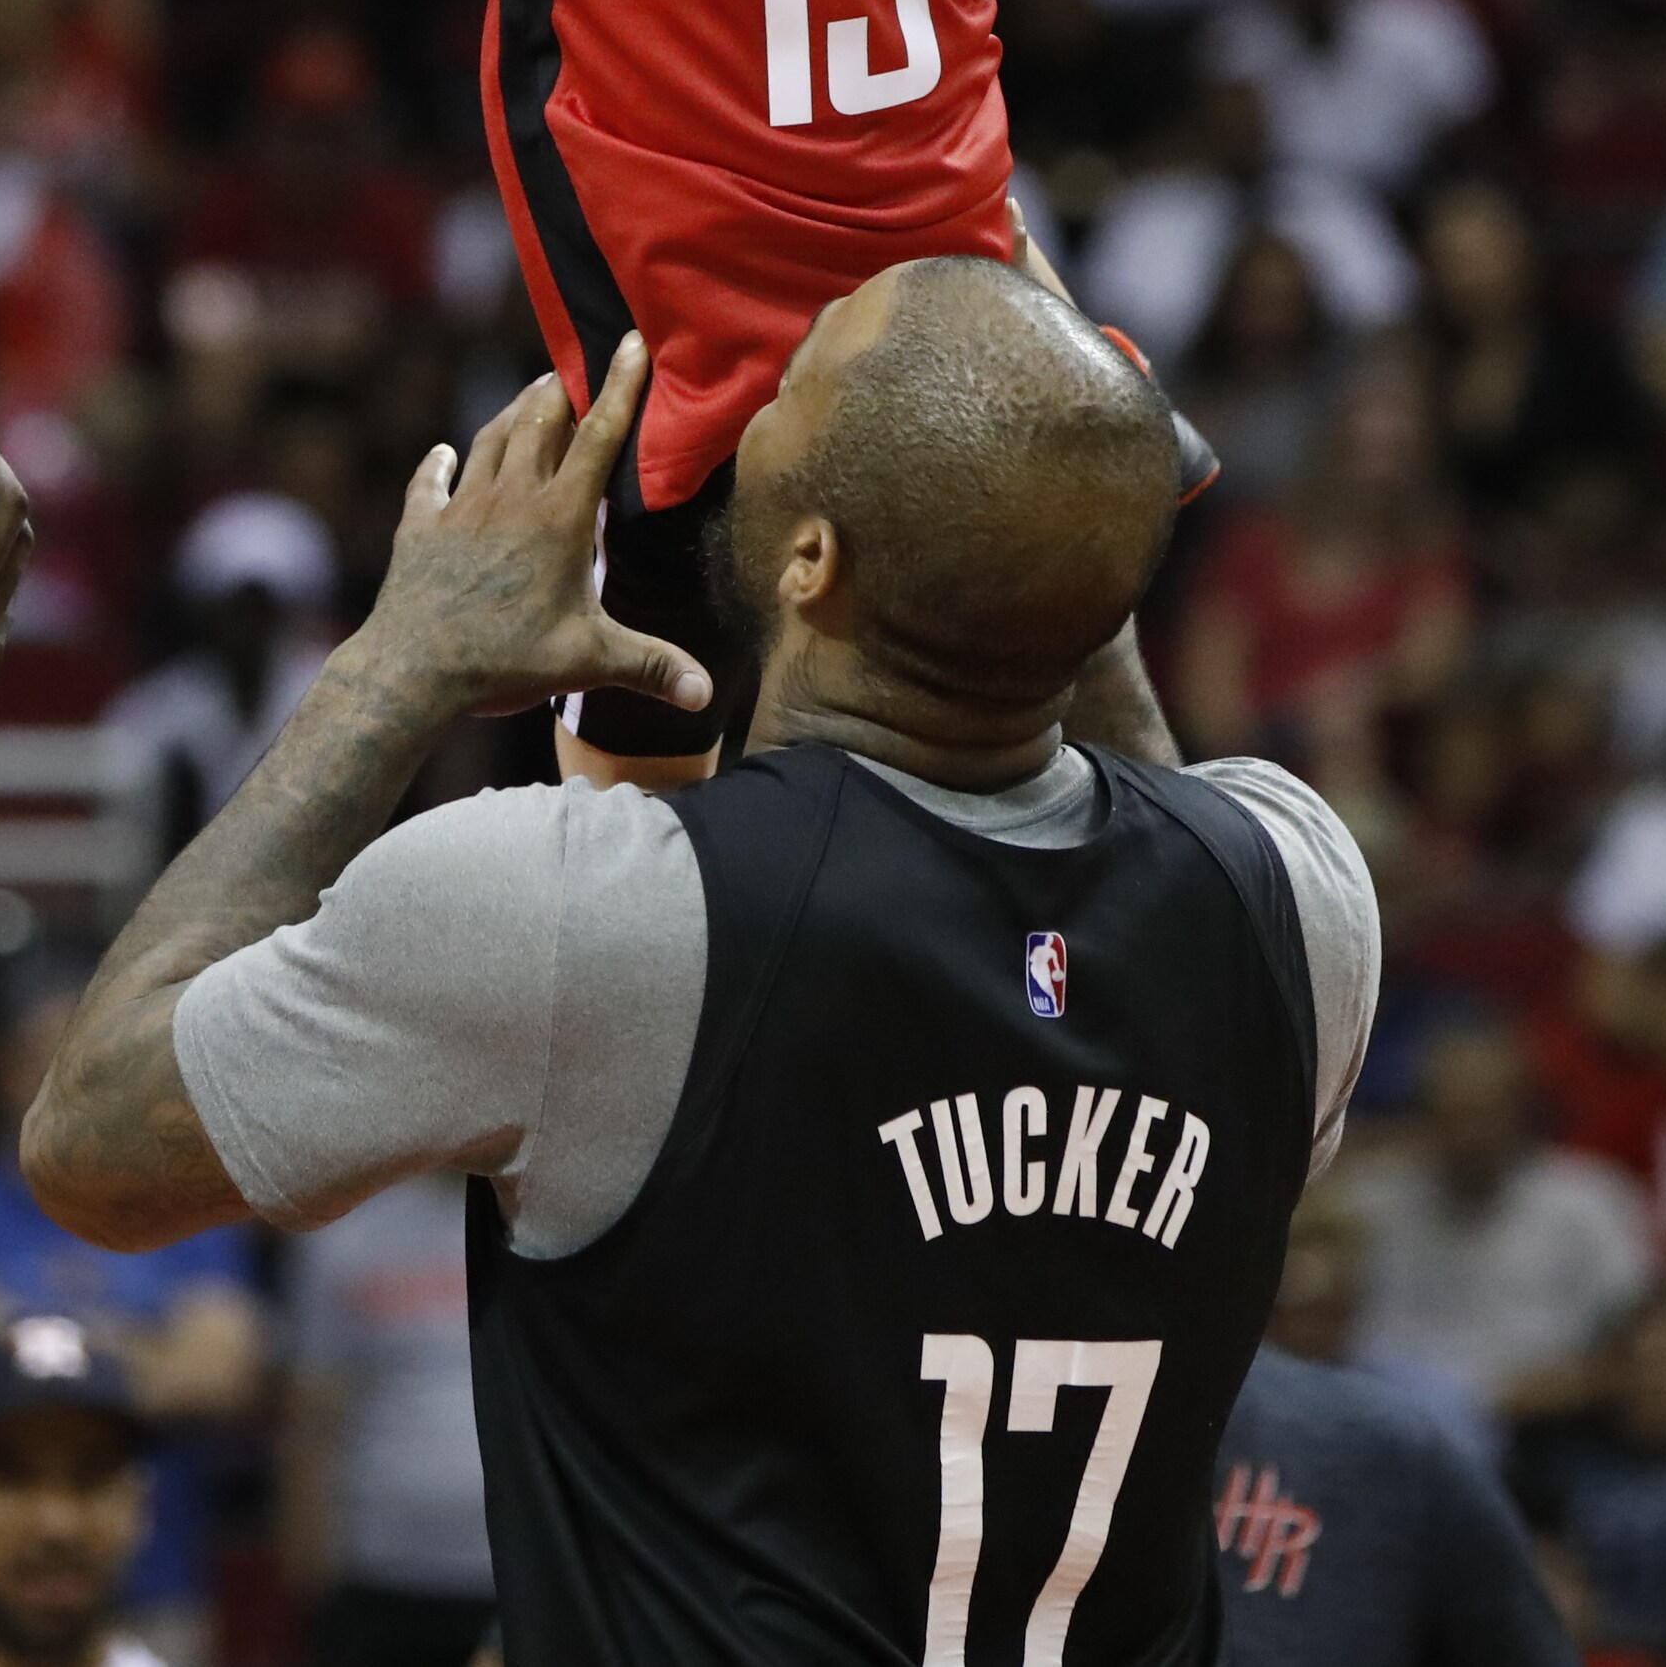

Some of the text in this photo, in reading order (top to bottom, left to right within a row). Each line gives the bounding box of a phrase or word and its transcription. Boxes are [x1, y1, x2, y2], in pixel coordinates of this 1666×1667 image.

[1033, 996, 1051, 1012] NBA
[878, 1085, 1211, 1249] TUCKER
[920, 1333, 1163, 1667] 17
